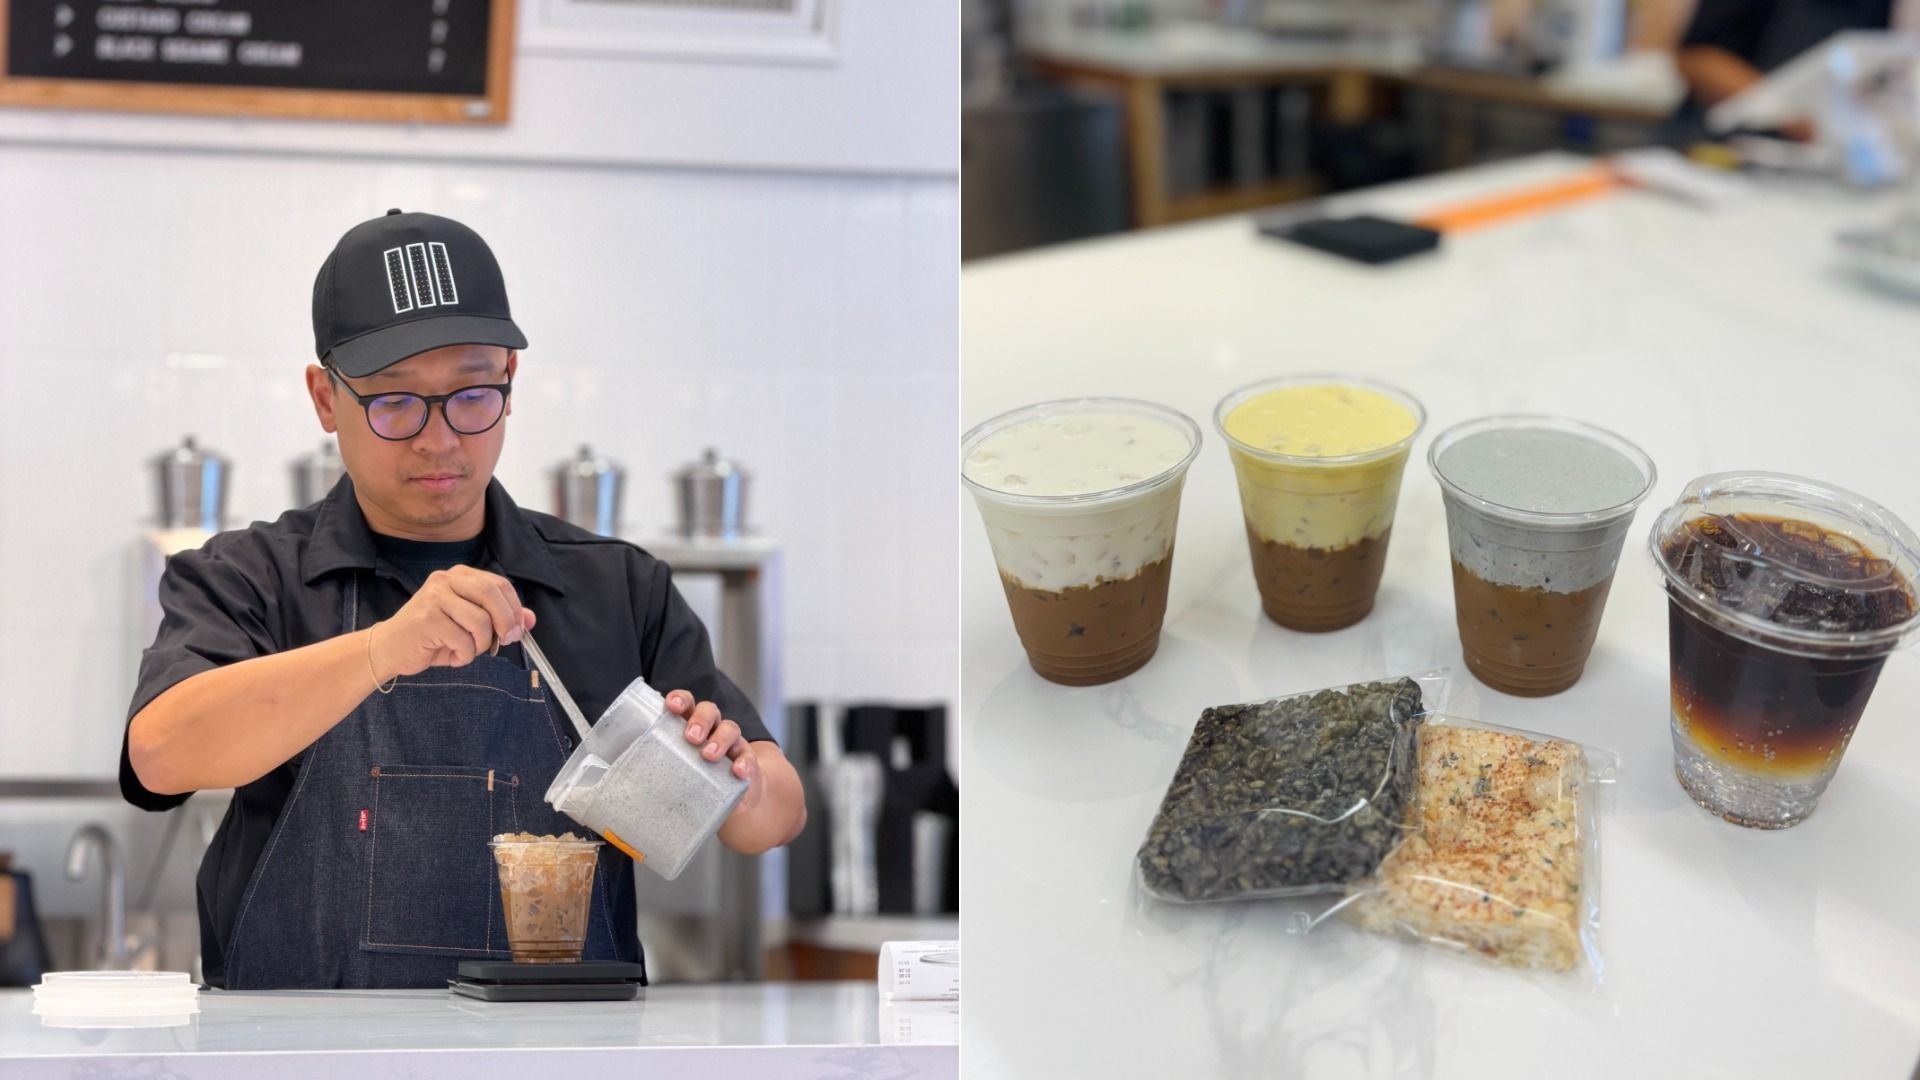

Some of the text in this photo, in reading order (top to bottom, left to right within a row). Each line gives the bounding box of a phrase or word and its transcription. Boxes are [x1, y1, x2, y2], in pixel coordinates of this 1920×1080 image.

[184, 11, 251, 36] CREAM
[95, 35, 156, 61] BLACK
[237, 42, 302, 67] CREAM
